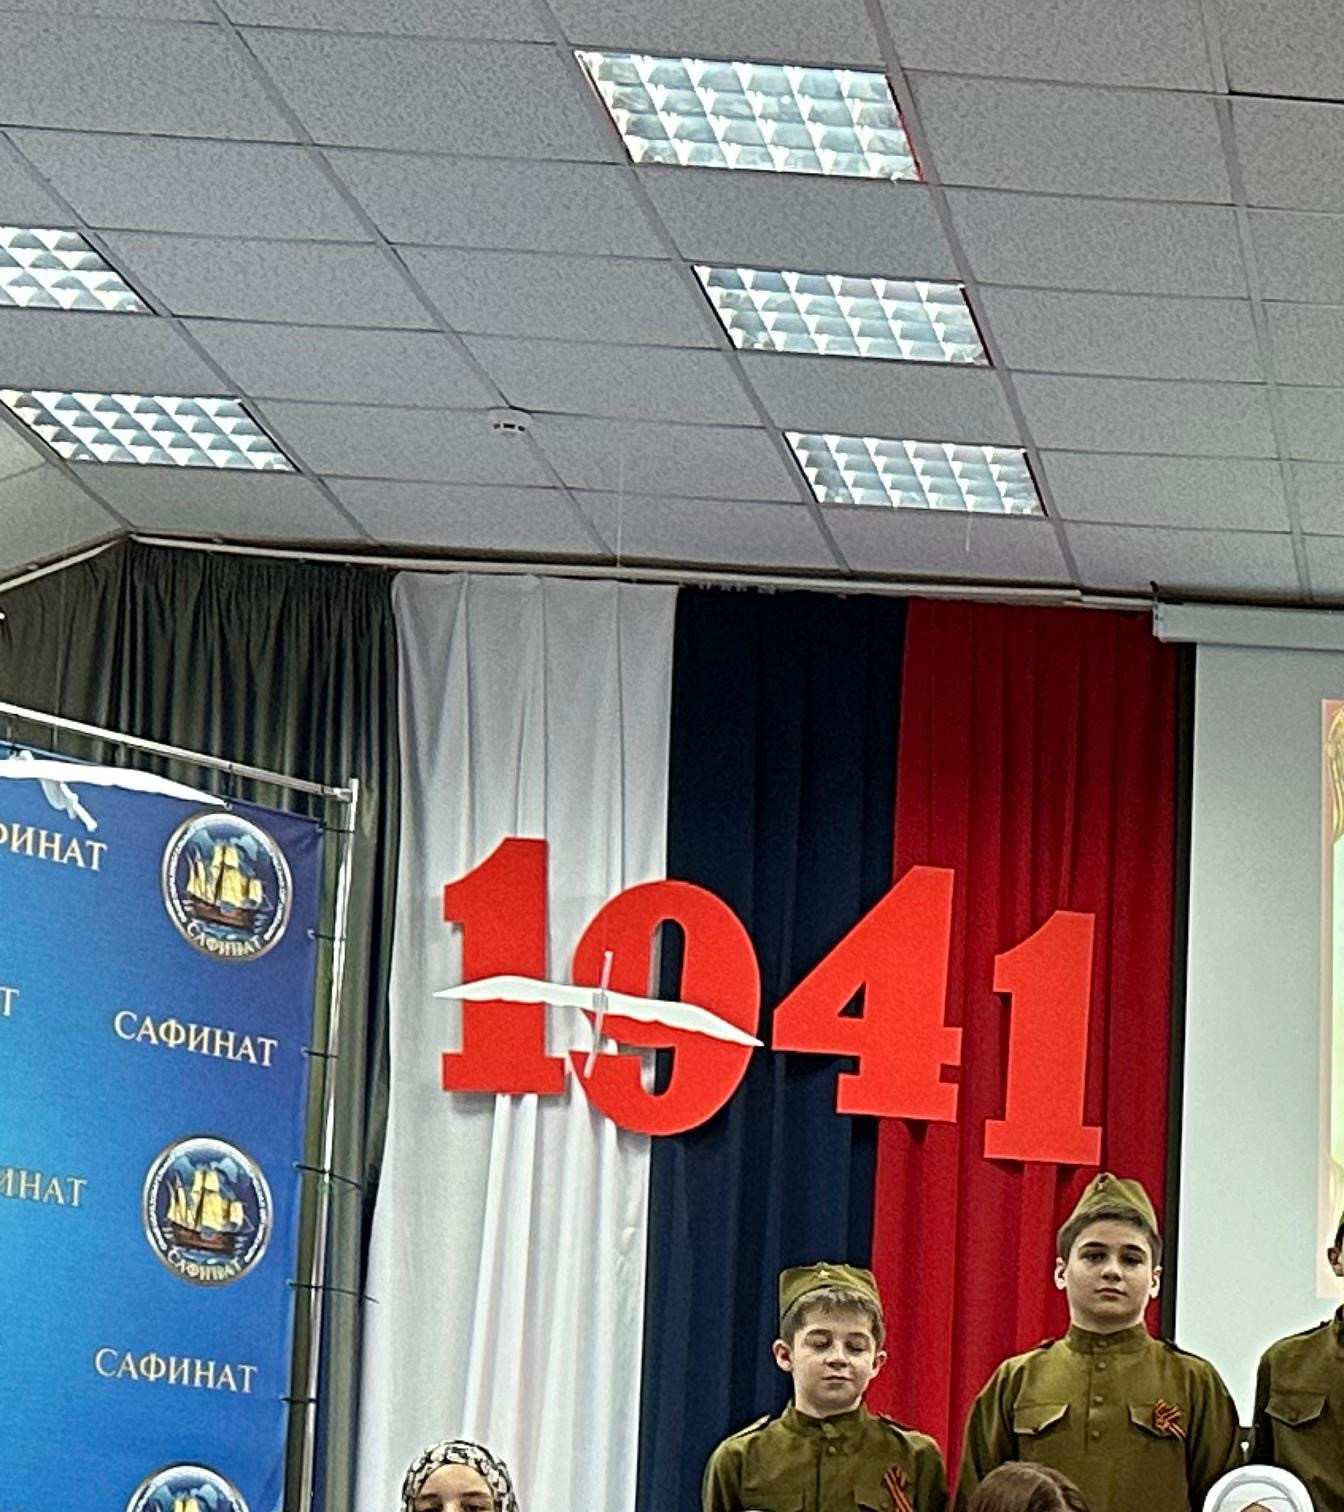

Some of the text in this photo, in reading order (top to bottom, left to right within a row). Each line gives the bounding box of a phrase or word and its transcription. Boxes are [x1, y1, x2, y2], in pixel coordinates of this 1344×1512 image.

[441, 836, 1102, 1166] 1941
[113, 1010, 279, 1067] САФИНАТ
[94, 1347, 259, 1394] САФИНАТ
